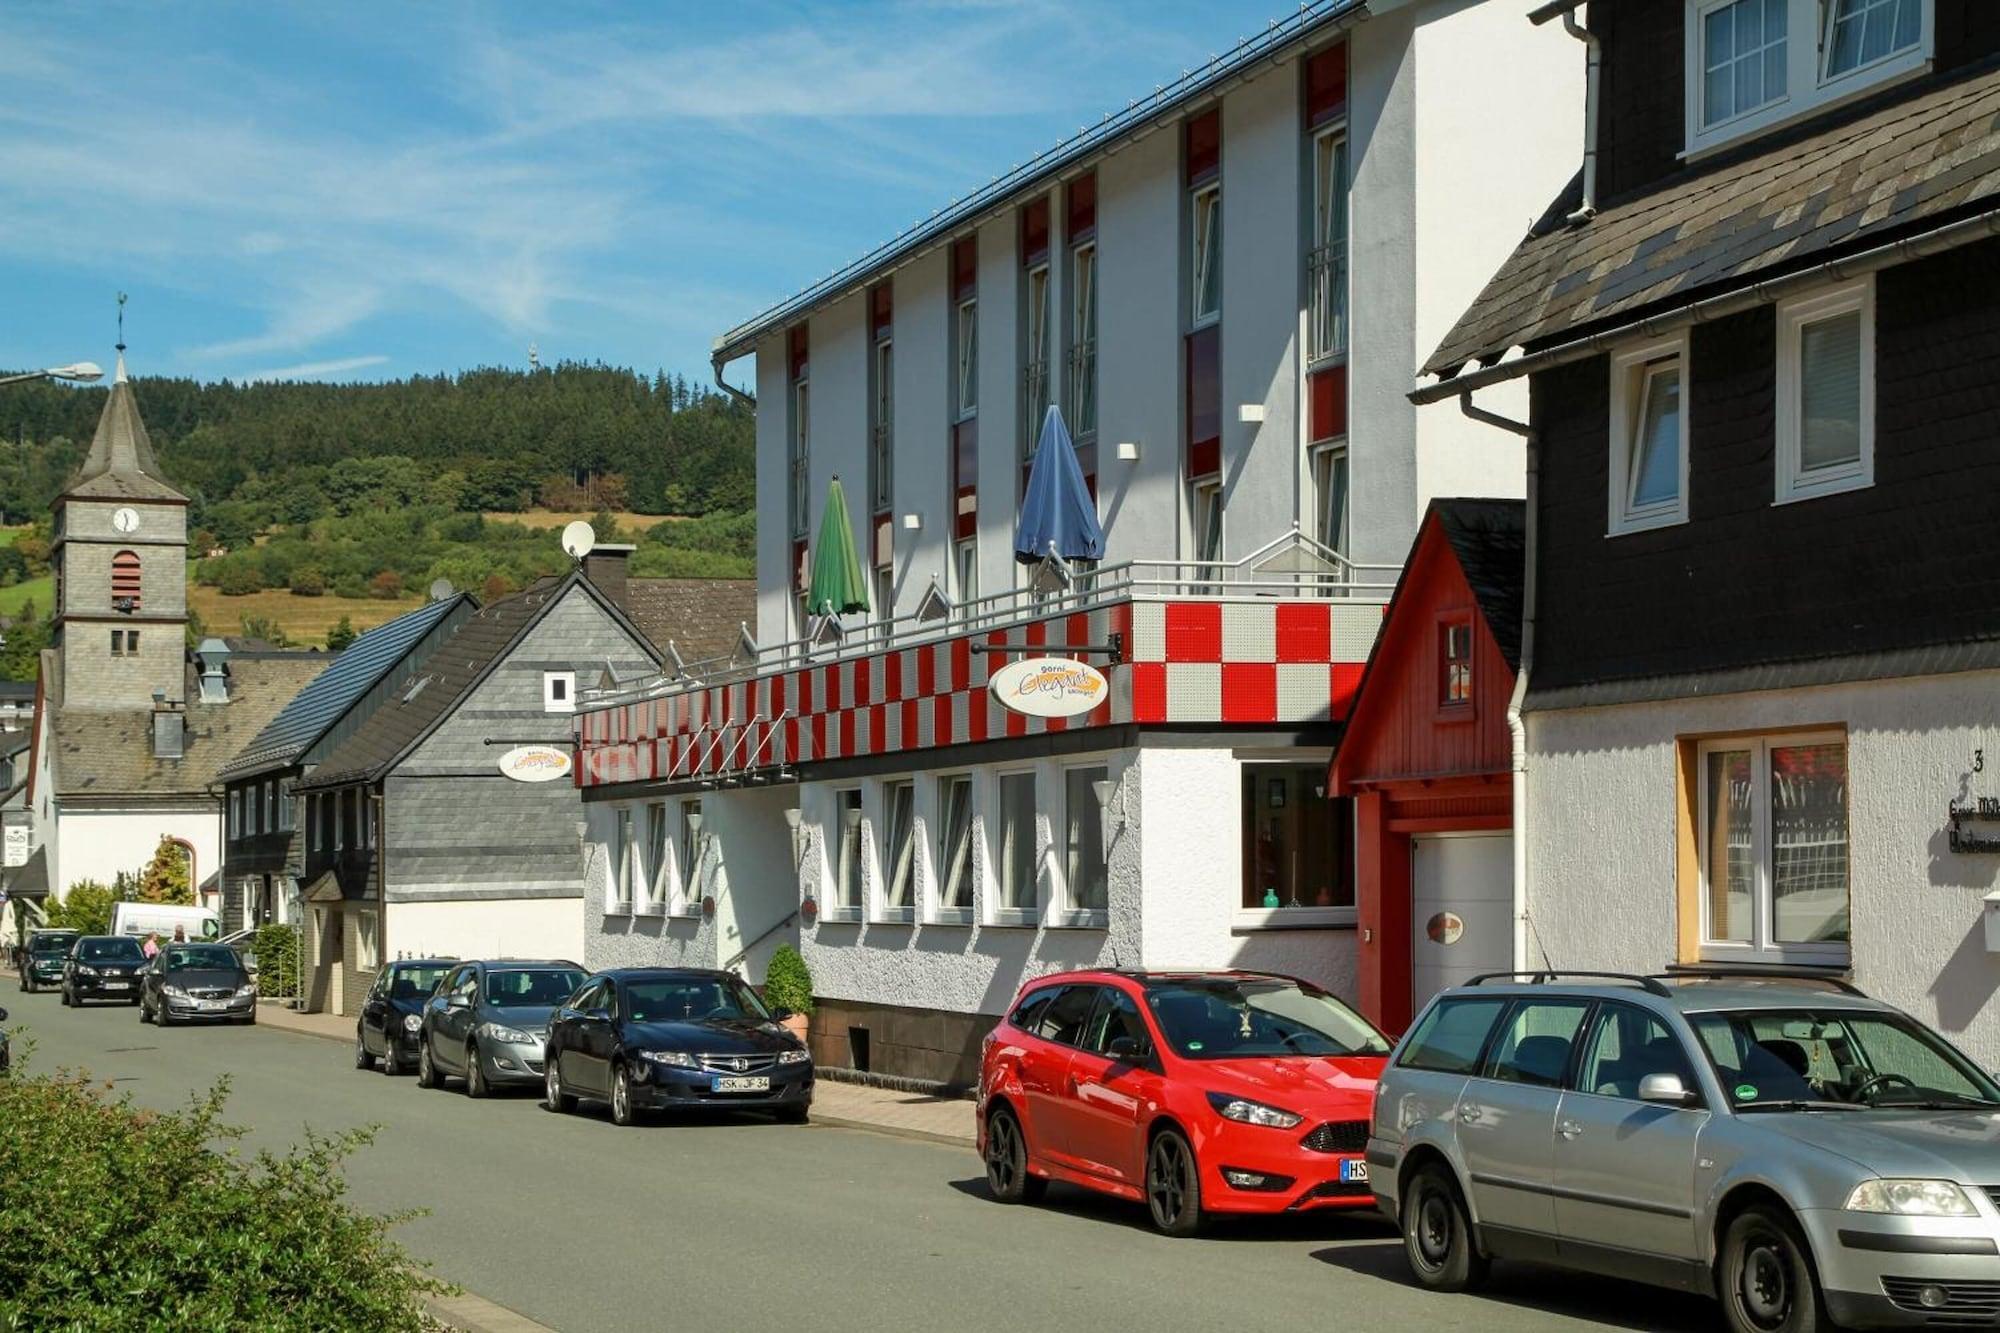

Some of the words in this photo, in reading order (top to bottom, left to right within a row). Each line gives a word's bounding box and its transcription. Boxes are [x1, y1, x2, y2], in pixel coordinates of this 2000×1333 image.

[1019, 667, 1088, 700] Elegant
[1974, 749, 1984, 772] 3
[719, 1079, 737, 1089] HSK
[1350, 1162, 1366, 1177] HS
